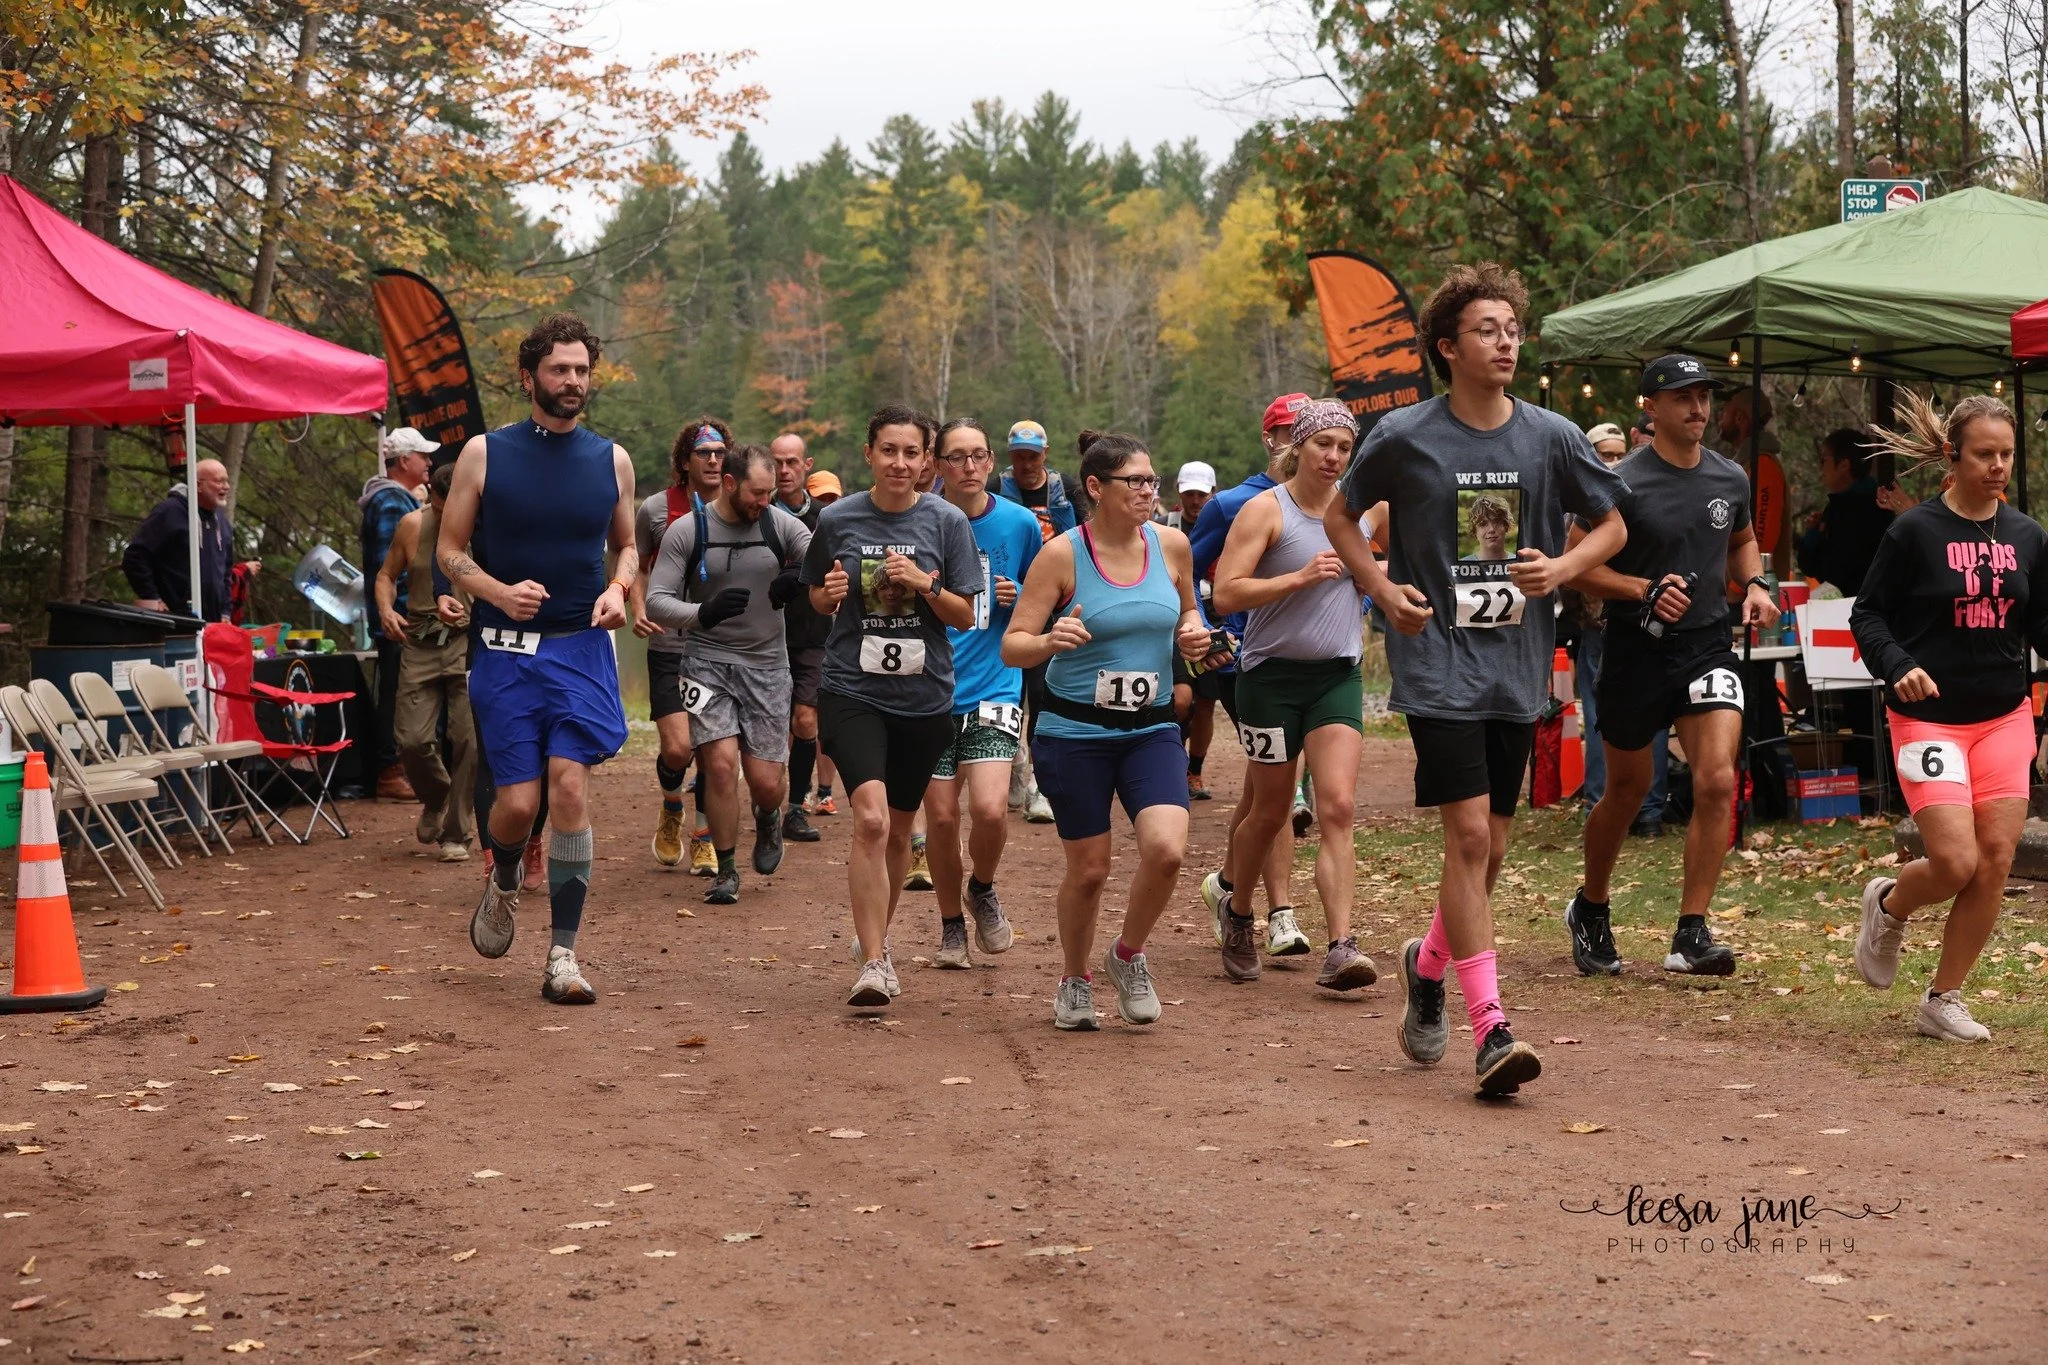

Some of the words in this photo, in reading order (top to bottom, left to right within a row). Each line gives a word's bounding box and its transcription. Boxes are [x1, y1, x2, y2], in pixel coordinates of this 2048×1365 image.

[1847, 184, 1877, 196] HELP
[1847, 198, 1878, 209] STOP
[446, 399, 468, 420] OUR
[1394, 386, 1420, 407] OUR
[1456, 472, 1482, 485] WE
[1486, 472, 1519, 484] RUN
[861, 545, 883, 555] WE
[1946, 542, 2018, 572] QUADS
[1451, 565, 1481, 577] FOR
[1469, 588, 1514, 624] 22
[1954, 596, 2015, 629] FURY
[861, 617, 887, 630] FOR
[889, 616, 921, 629] JACK
[489, 629, 526, 650] 11
[881, 643, 902, 672] 8
[680, 681, 701, 709] 39
[1108, 677, 1150, 708] 19
[1701, 673, 1738, 700] 13
[990, 706, 1021, 734] 15
[1243, 729, 1276, 759] 32
[1922, 746, 1945, 778] 6
